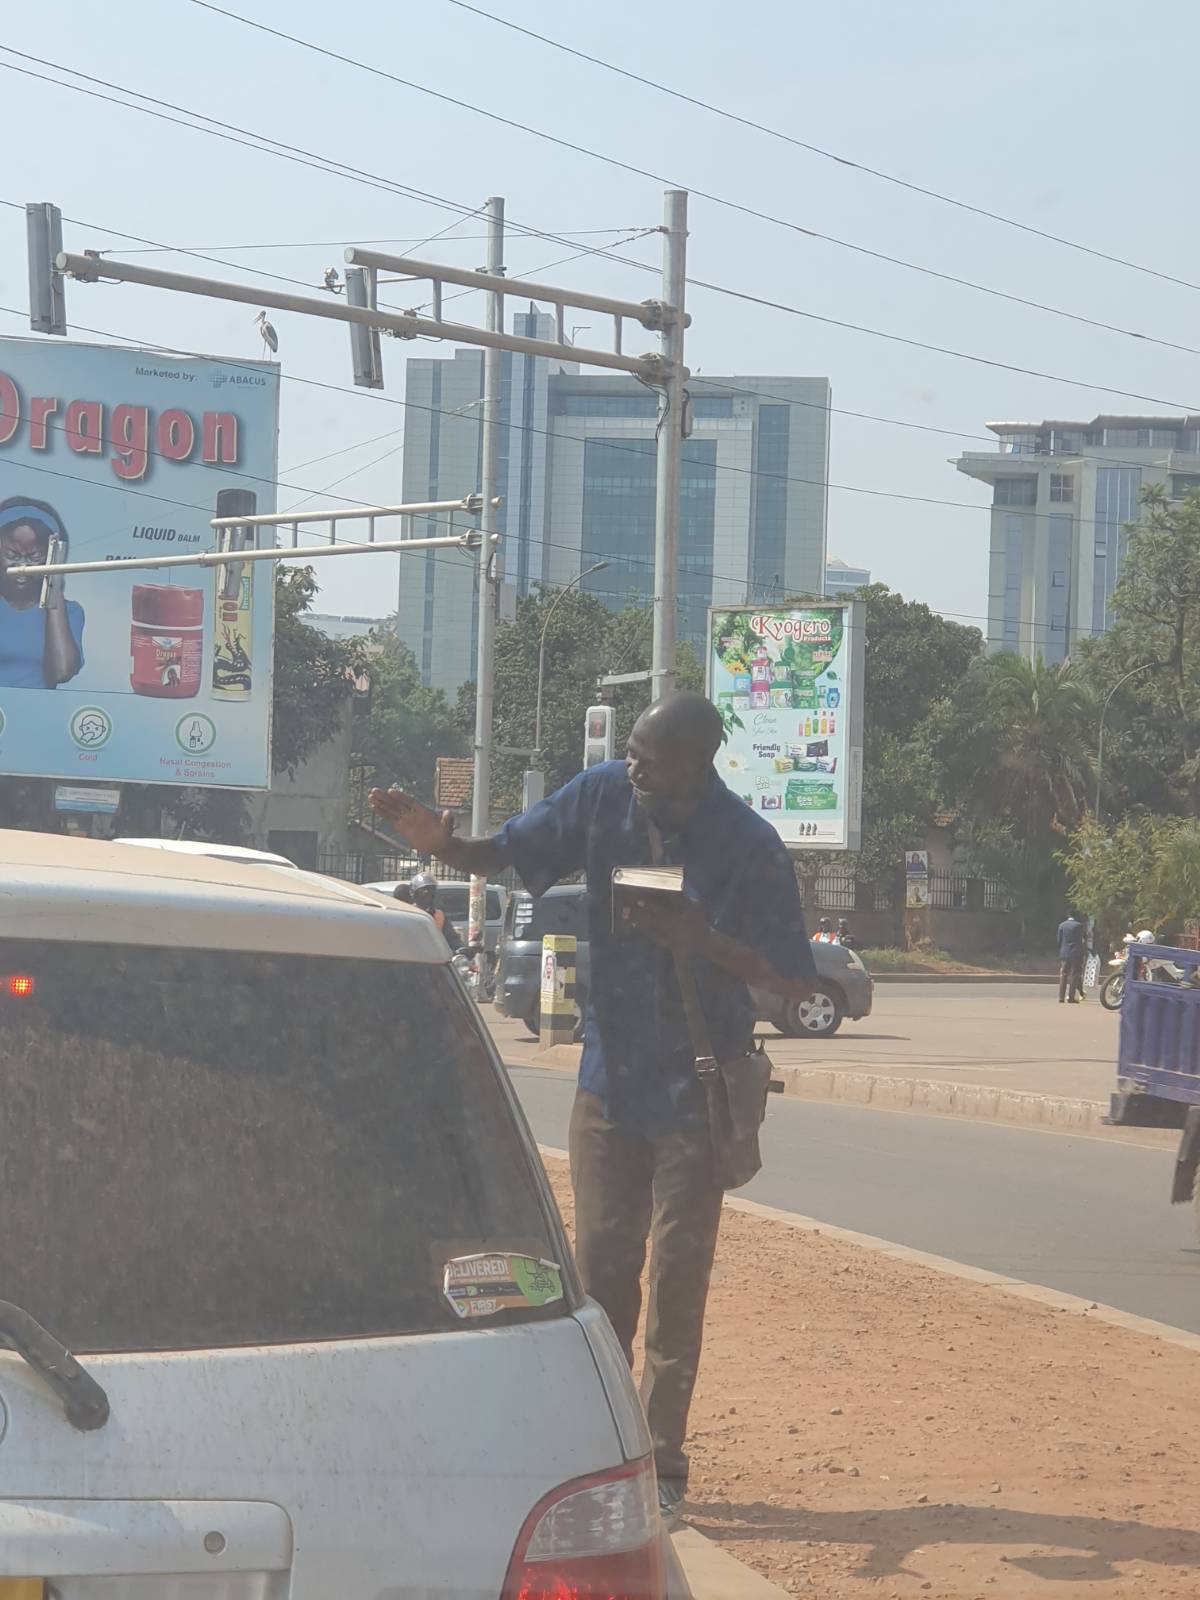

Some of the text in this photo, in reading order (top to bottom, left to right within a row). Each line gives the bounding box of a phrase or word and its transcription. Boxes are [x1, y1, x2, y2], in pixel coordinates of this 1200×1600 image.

[135, 367, 180, 379] Marketed
[228, 375, 266, 386] ABACUS
[132, 526, 201, 543] LIQUID BALM
[751, 616, 831, 642] Kyogero
[752, 743, 781, 752] Friendly
[79, 753, 98, 761] Cold
[758, 751, 776, 759] Soap
[159, 757, 232, 769] Nasal Congestion
